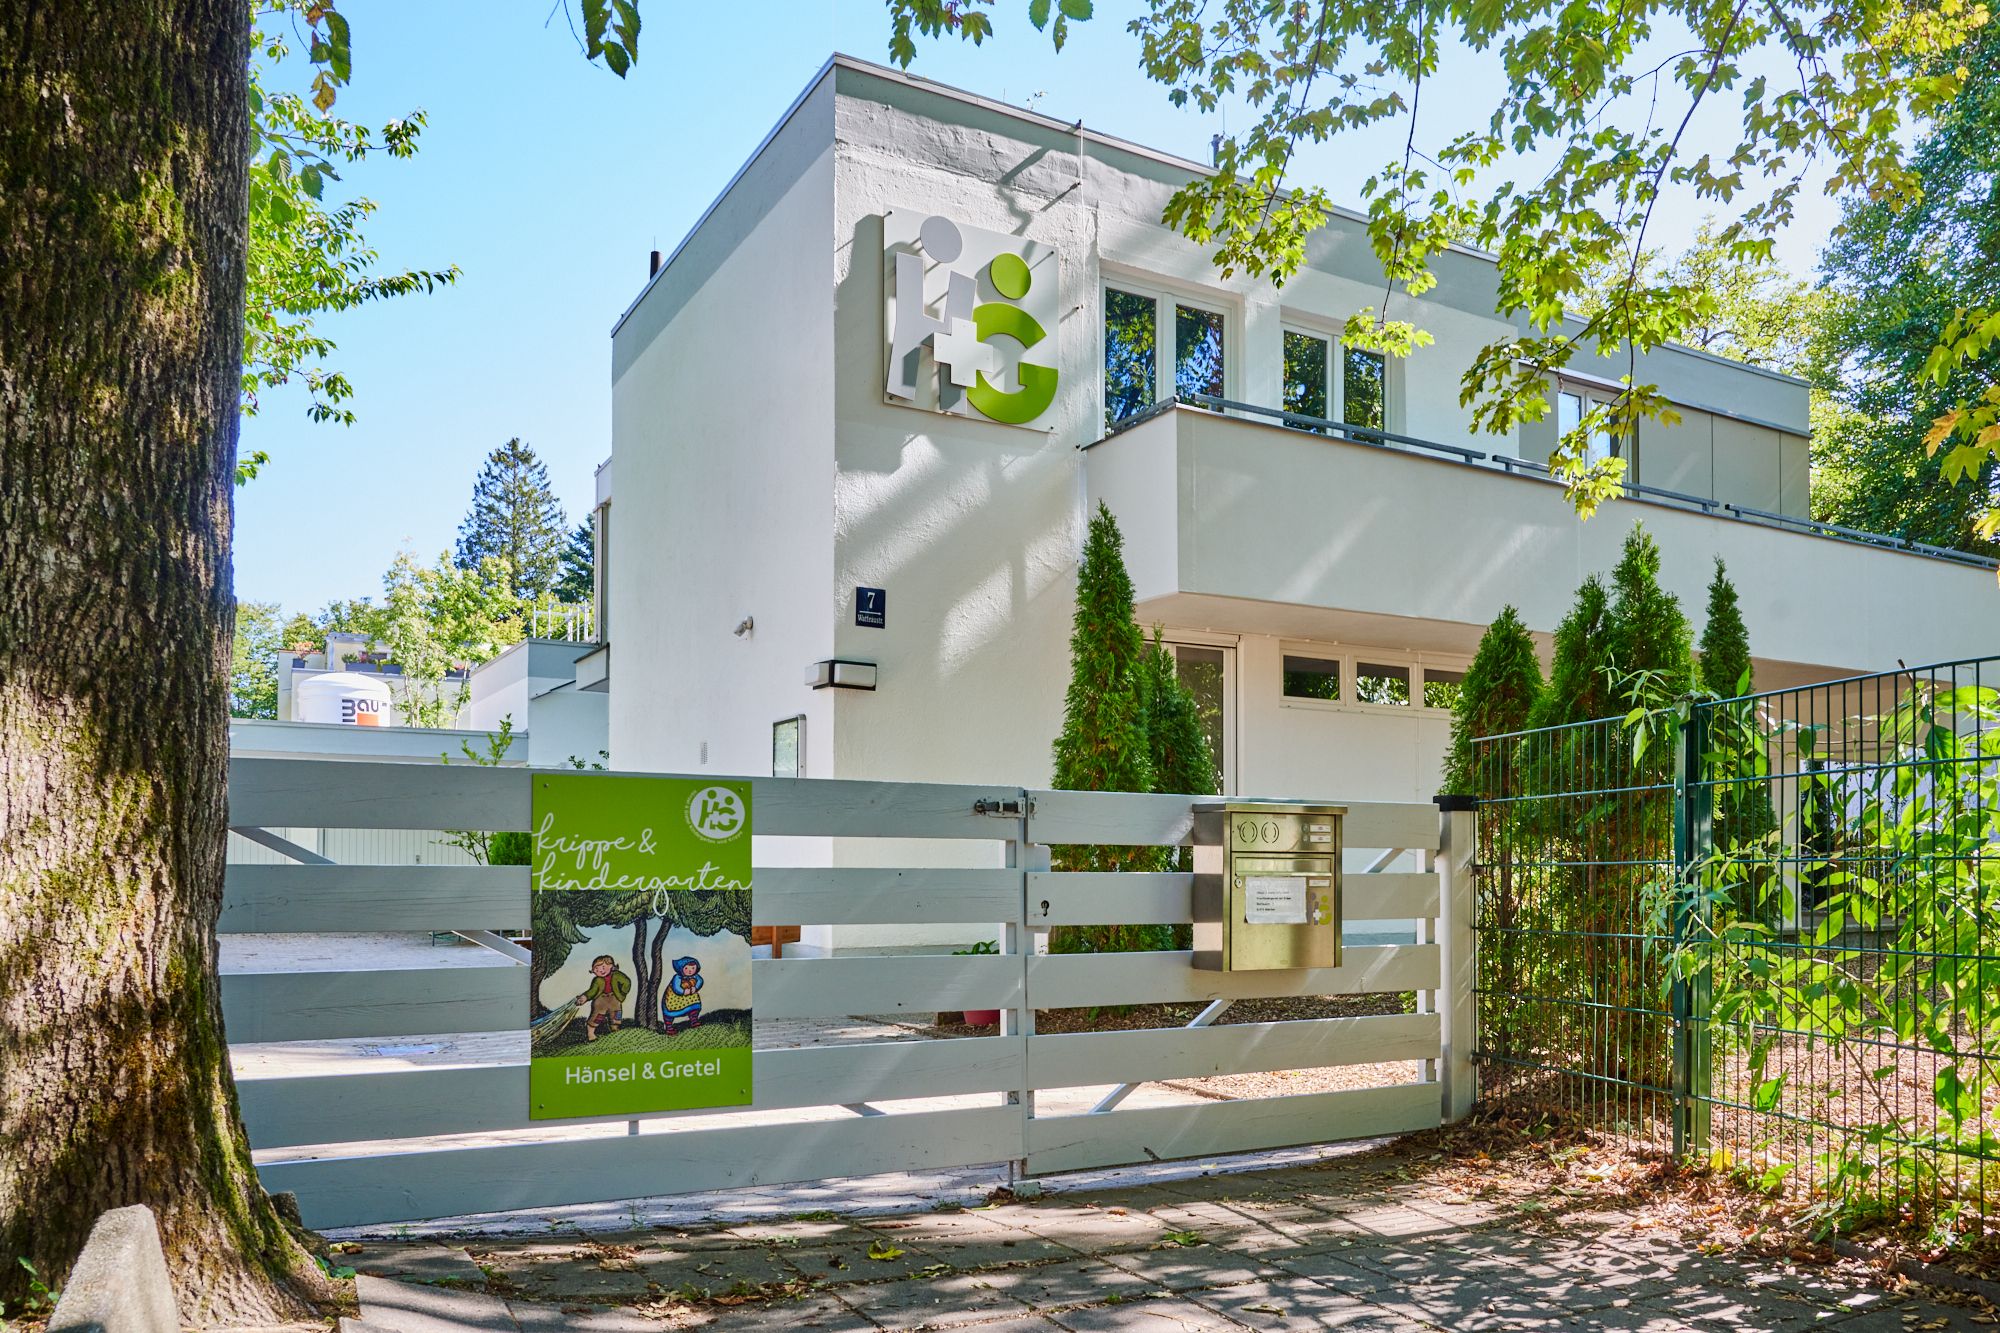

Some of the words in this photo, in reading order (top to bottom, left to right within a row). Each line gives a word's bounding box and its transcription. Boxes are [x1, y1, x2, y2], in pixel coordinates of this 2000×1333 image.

[867, 591, 876, 609] 7
[532, 812, 635, 870] krippe
[638, 828, 657, 855] &
[532, 851, 752, 916] kindergarten
[565, 1062, 635, 1085] Hänsel
[642, 1063, 656, 1080] &
[659, 1058, 721, 1079] Gretel
